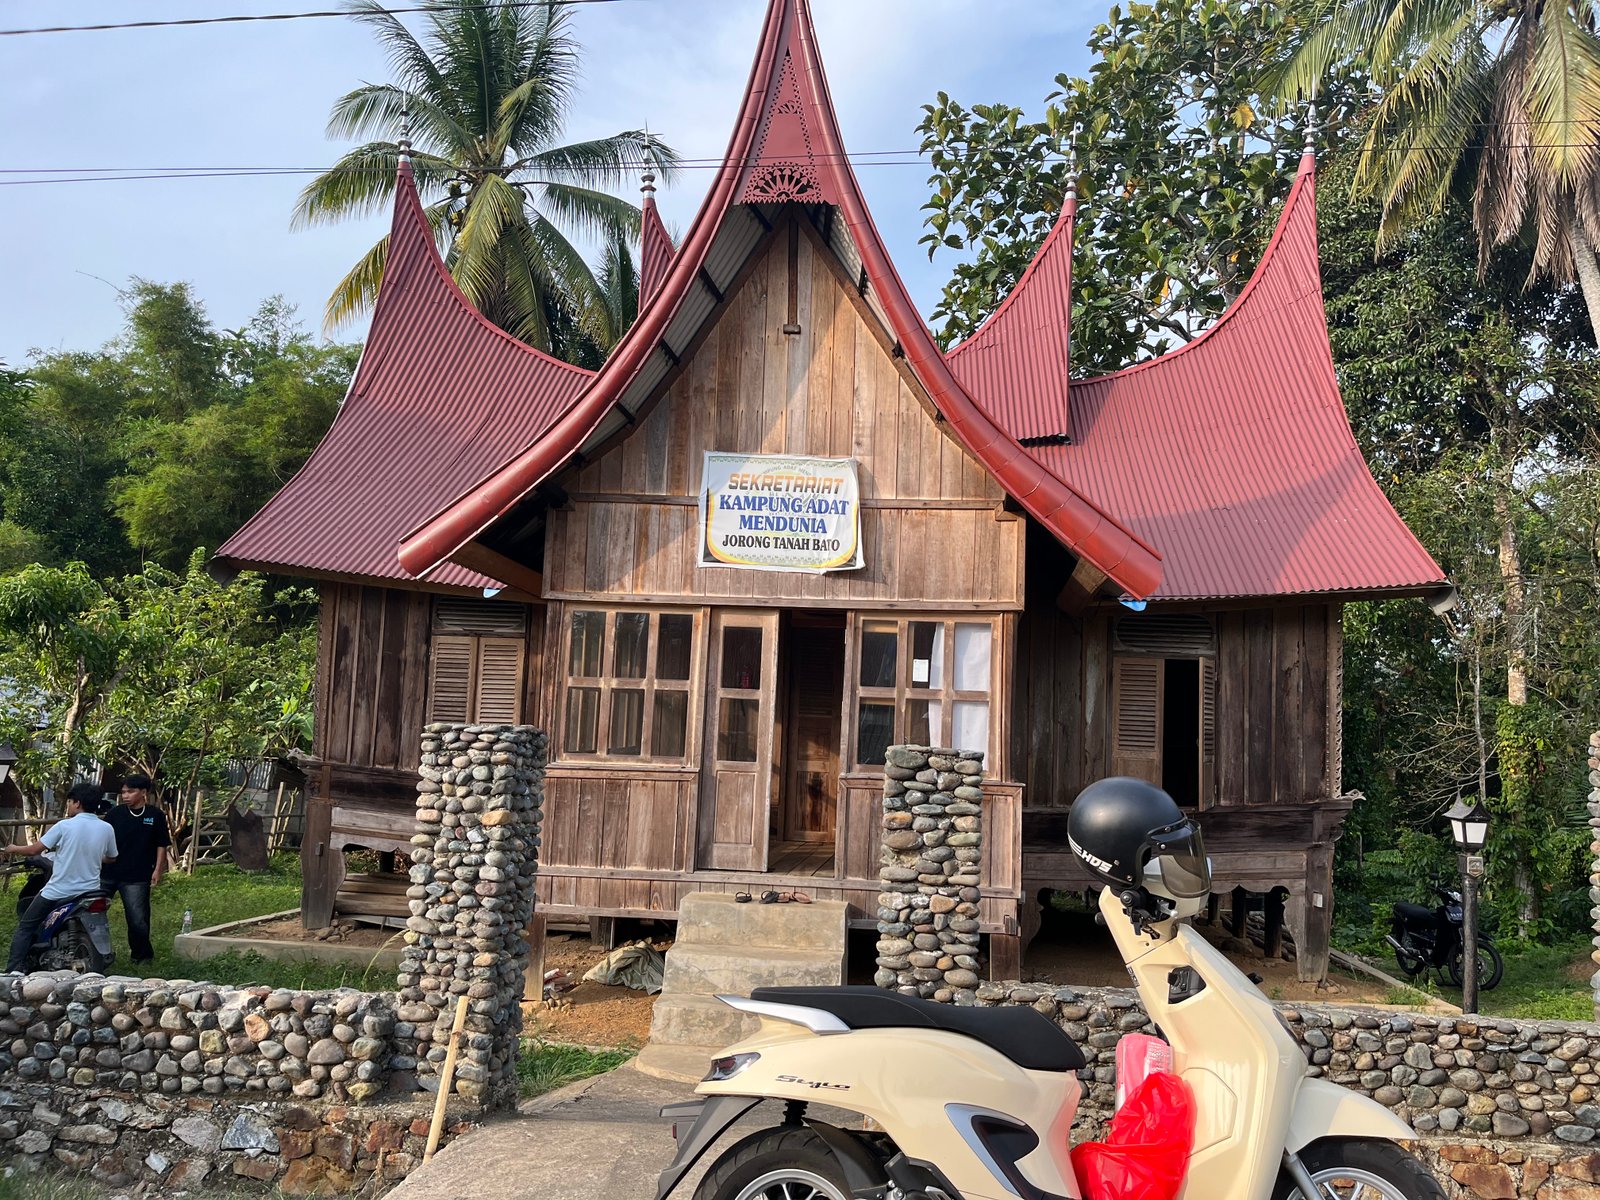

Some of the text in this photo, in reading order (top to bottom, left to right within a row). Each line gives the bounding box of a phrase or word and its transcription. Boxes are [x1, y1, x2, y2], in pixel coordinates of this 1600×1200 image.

[728, 473, 844, 494] SEKRETARIAT
[719, 494, 849, 515] KAMPUNG ADAT
[739, 514, 828, 533] MENDUNIA
[722, 534, 771, 549] JORONG
[773, 536, 810, 550] TANAH
[775, 1075, 850, 1091] Stylo
